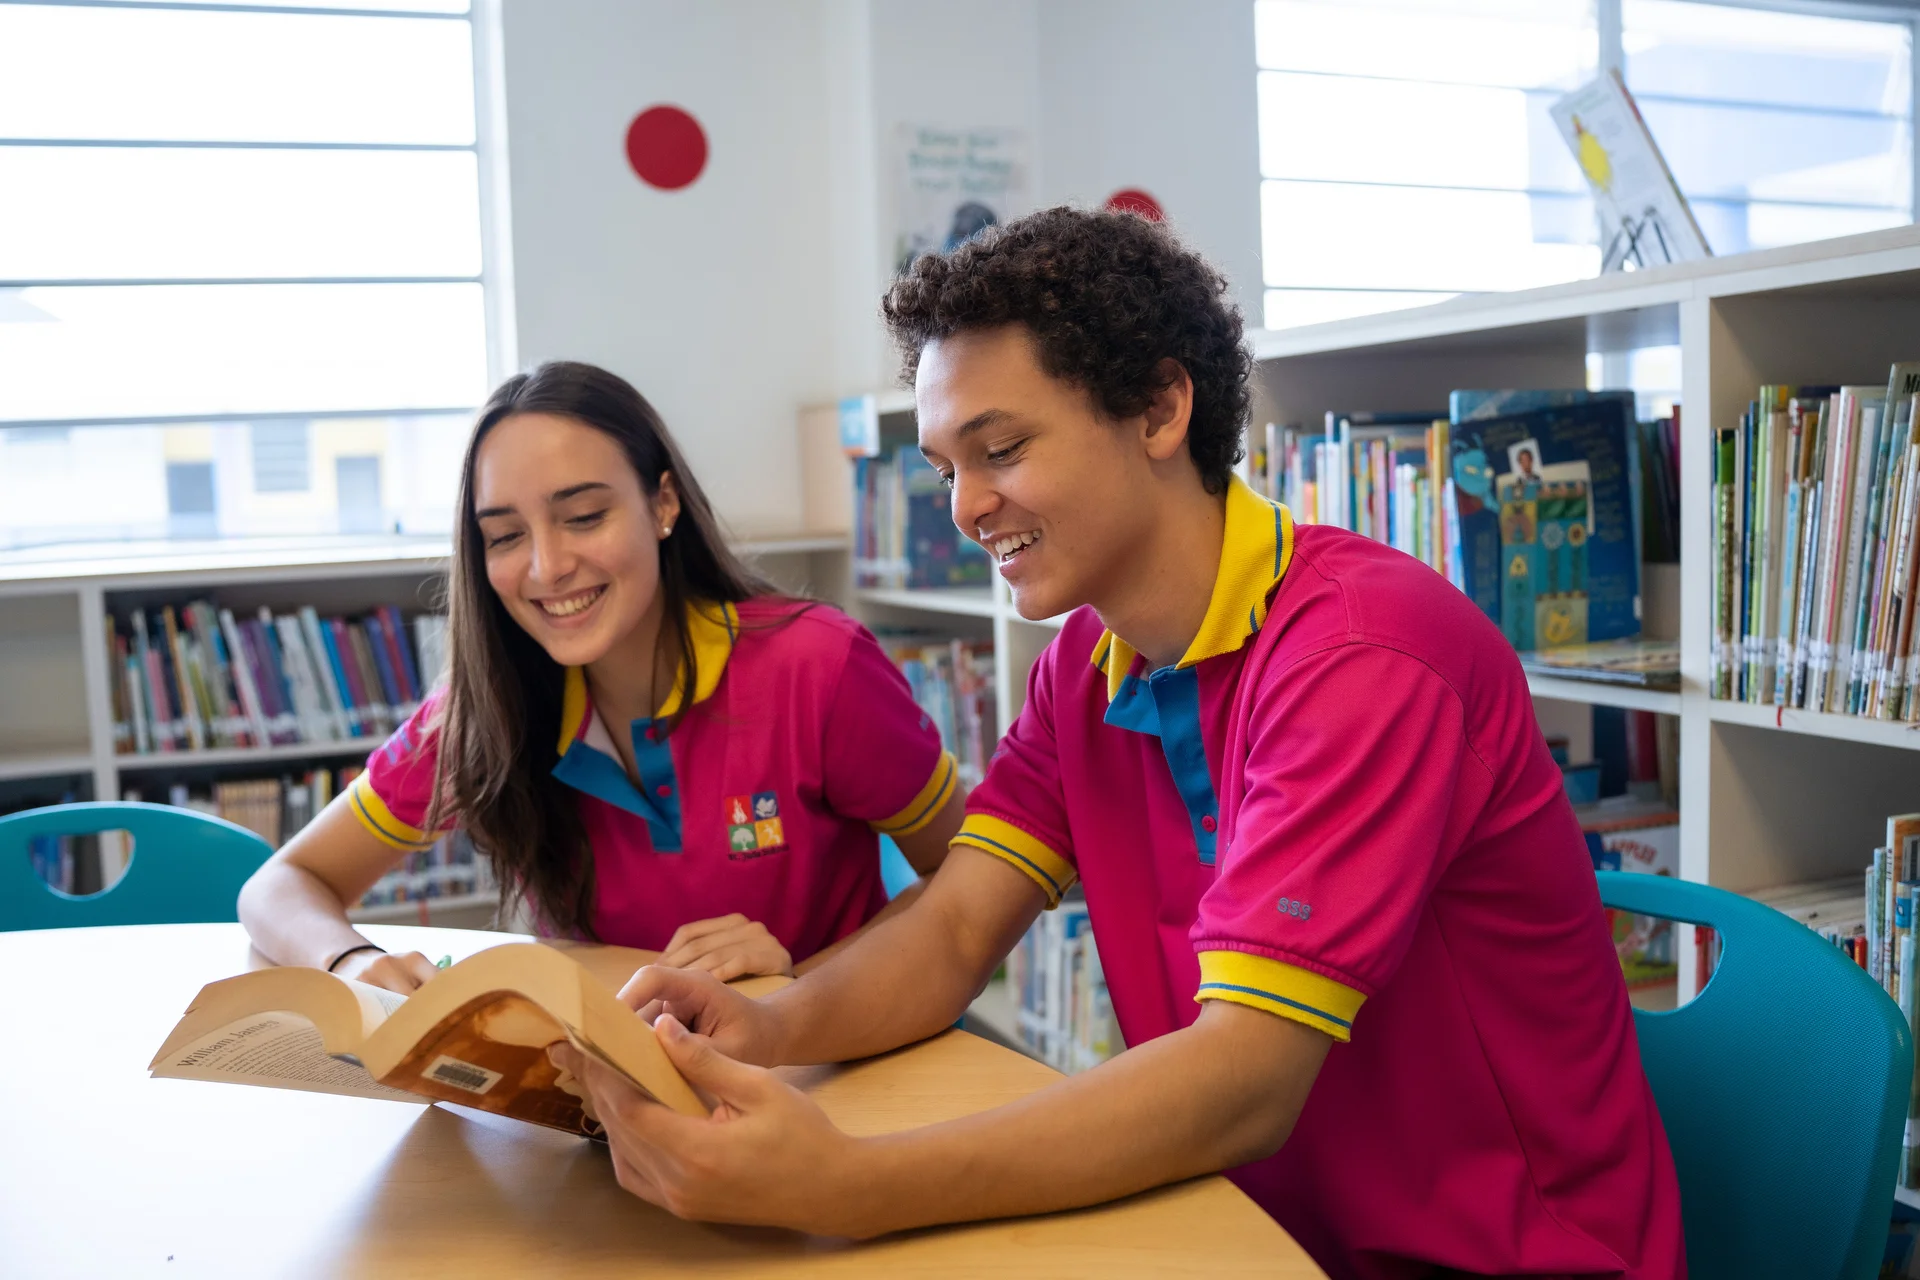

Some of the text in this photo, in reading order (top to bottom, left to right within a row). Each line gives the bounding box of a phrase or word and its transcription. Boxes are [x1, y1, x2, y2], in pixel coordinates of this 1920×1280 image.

[1277, 896, 1312, 921] SSS
[176, 1037, 235, 1067] William
[229, 1019, 280, 1039] James
